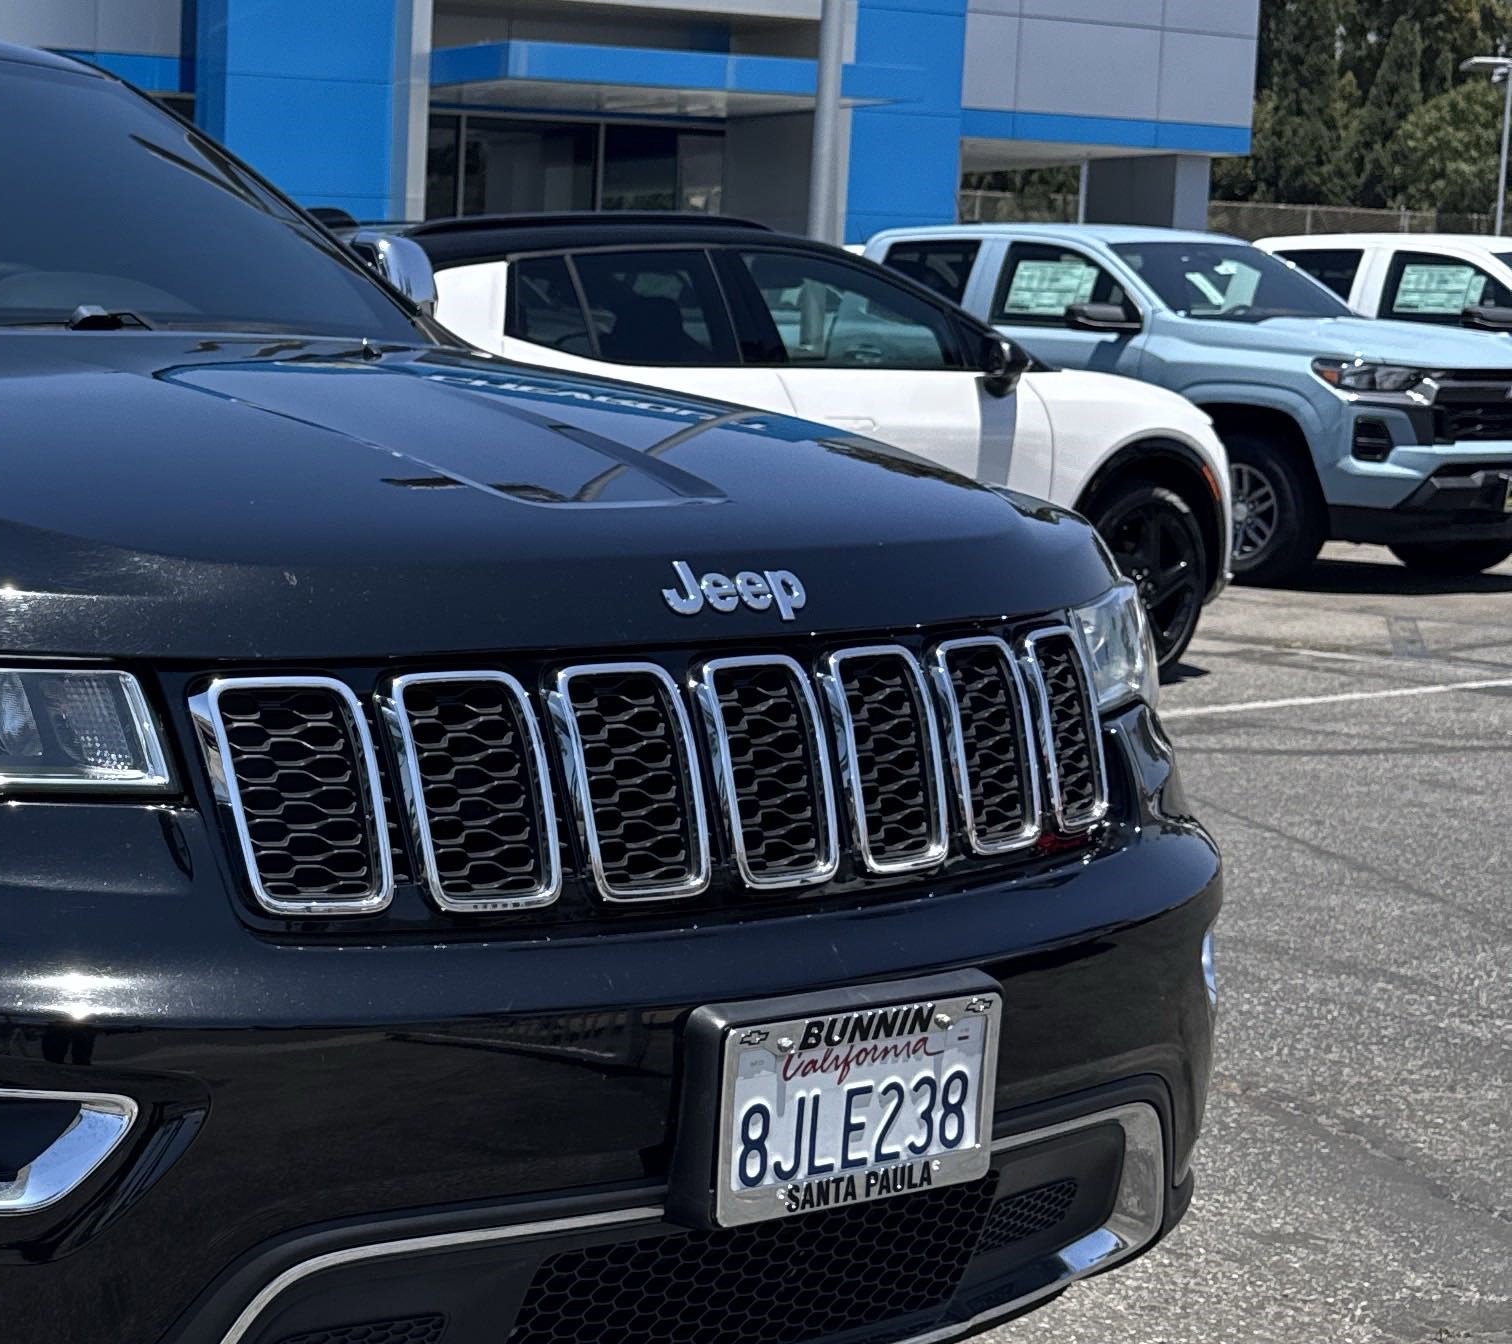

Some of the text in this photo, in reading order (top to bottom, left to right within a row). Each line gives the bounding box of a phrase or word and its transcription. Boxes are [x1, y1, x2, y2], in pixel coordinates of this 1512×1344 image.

[661, 560, 807, 621] Jeep
[798, 1004, 937, 1051] BUNNIN
[781, 1035, 945, 1085] California
[738, 1068, 970, 1188] 8JLE238
[786, 1159, 933, 1213] SANTA PAULA
